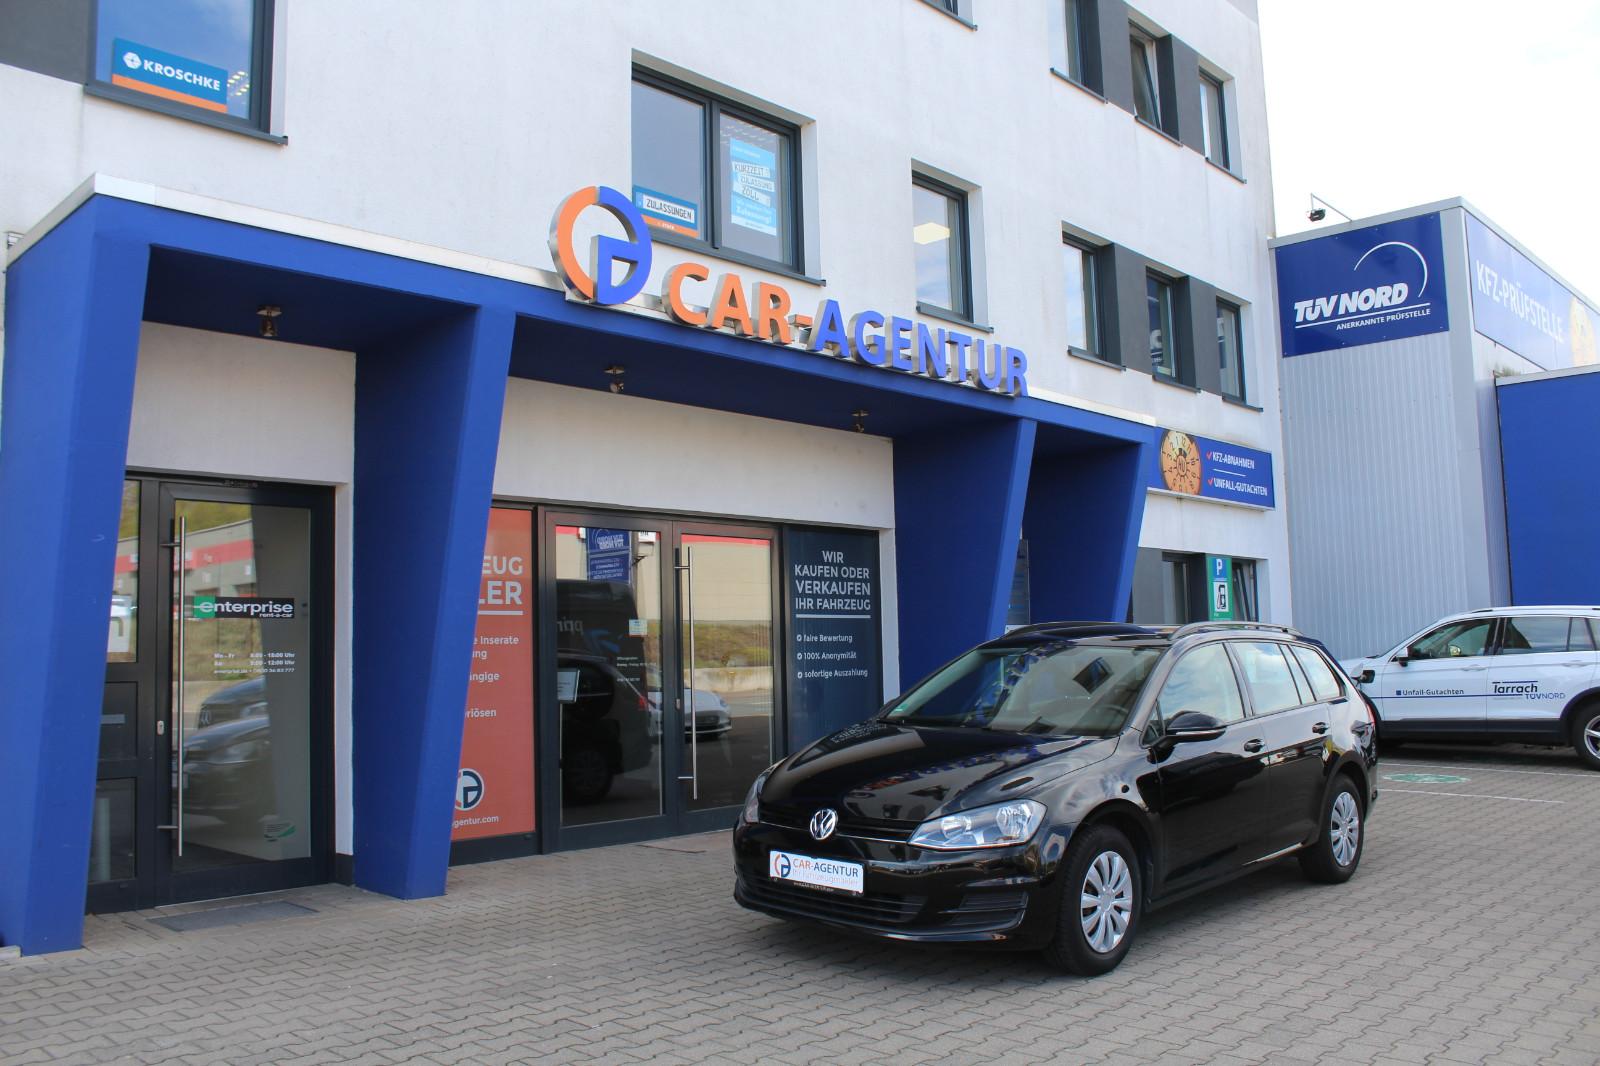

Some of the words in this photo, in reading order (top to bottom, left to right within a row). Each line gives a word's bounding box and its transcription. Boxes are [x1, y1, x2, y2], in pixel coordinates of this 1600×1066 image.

[143, 59, 221, 91] KROSCHKE
[741, 185, 760, 201] ZOLL
[646, 198, 692, 220] ZULASSUNGEN
[1294, 294, 1338, 322] TÜV
[1338, 282, 1409, 315] NORD
[1476, 260, 1564, 343] KFZ-PRÜFSTELLE
[1336, 316, 1385, 331] ANERKANNTE
[1386, 308, 1431, 323] PRÜFSTELLE
[664, 262, 1029, 397] CAR-AGENTUR
[1213, 451, 1255, 470] KFZ-ABNAHMEN
[1213, 477, 1268, 497] UNFALL-GUTACHTEN
[821, 550, 844, 564] WIR
[794, 564, 839, 578] KAUFEN
[841, 566, 870, 579] ODER
[1215, 558, 1224, 575] P
[795, 580, 871, 596] VERKAUFEN
[199, 601, 294, 616] enterprise
[795, 597, 814, 610] IHR
[816, 598, 871, 611] FAHRZEUG
[480, 636, 520, 645] Inserate
[803, 634, 818, 642] faire
[820, 634, 853, 643] Bewertung
[803, 652, 820, 660] 100%
[821, 651, 857, 661] Anonymität
[804, 669, 833, 679] sofortige
[834, 667, 868, 678] Auszahlung
[1492, 680, 1538, 694] Tarrach
[793, 858, 859, 878] CAR-AGENTUR
